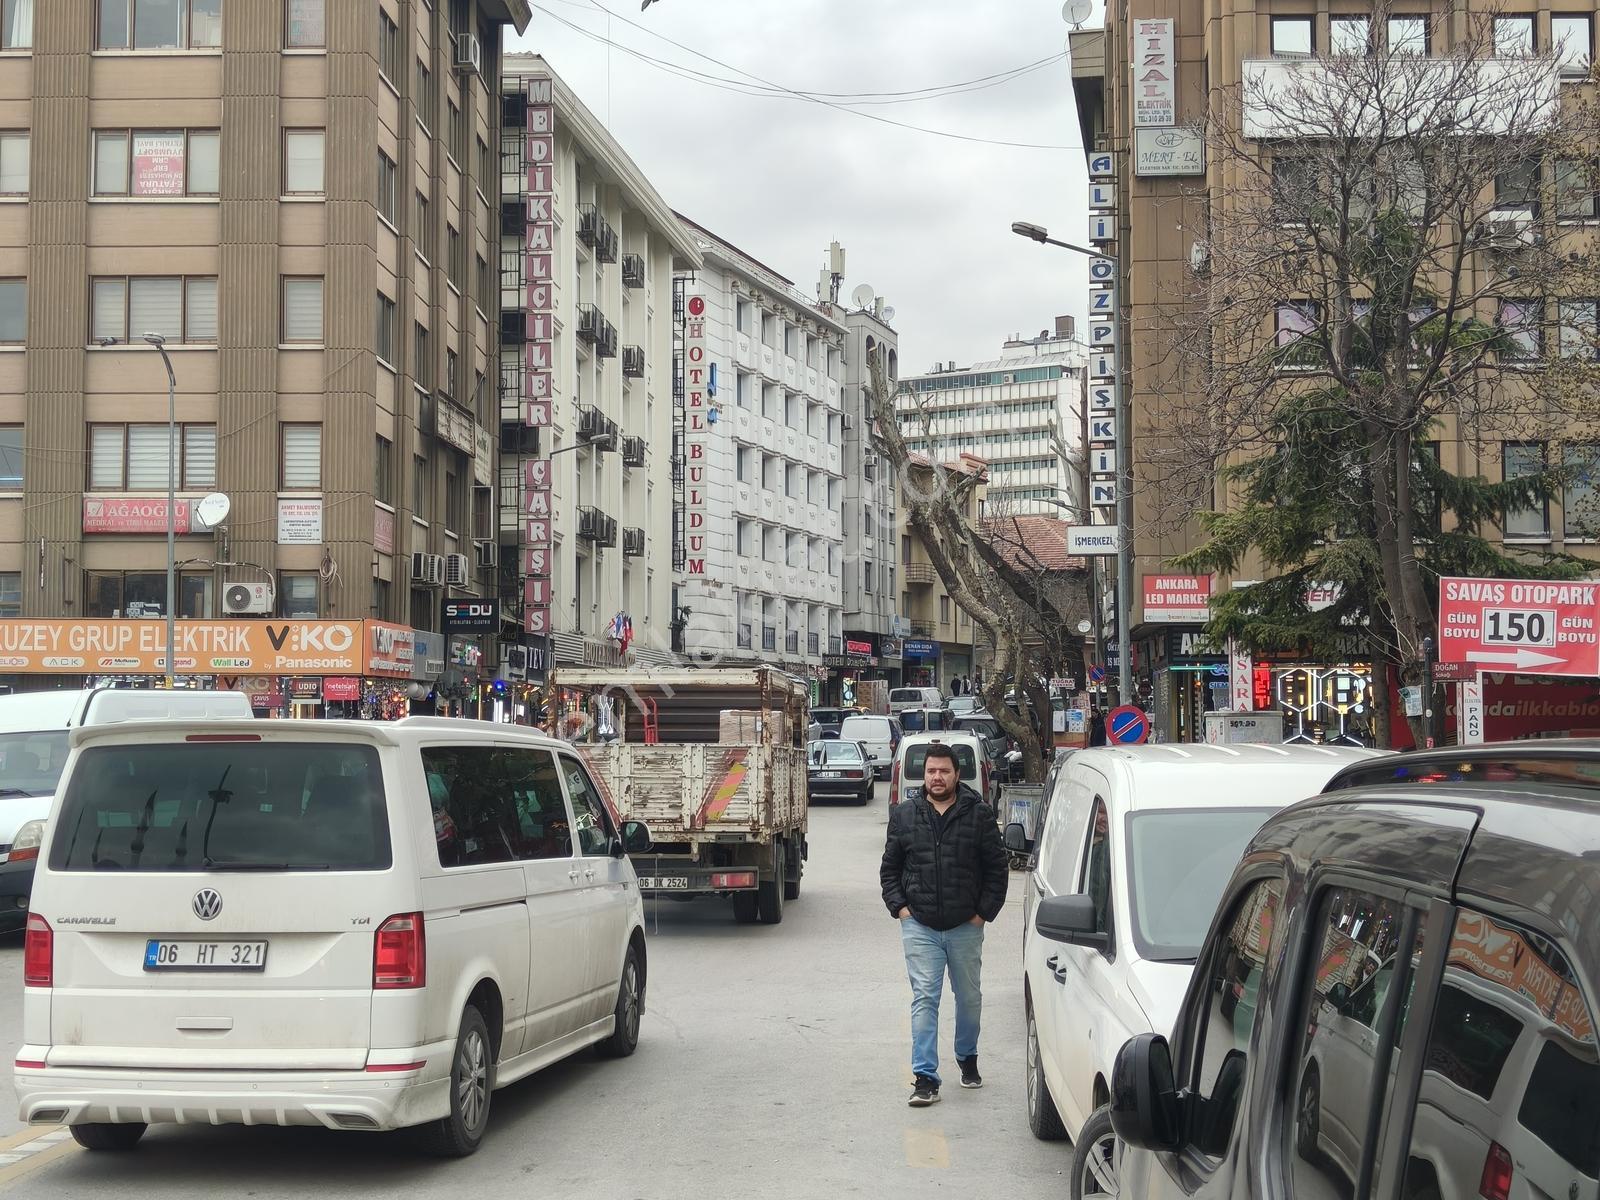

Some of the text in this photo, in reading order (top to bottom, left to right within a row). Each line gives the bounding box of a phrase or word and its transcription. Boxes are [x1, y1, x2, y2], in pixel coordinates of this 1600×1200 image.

[1139, 23, 1169, 97] HIZAL
[1138, 97, 1171, 109] ELEKTRİK
[1142, 151, 1176, 163] MERT
[139, 180, 183, 188] E-FATURA
[1091, 156, 1114, 501] ALİ ÖZPİŞKİN
[688, 324, 705, 574] HOTEL BULDUM
[1155, 578, 1199, 590] ANKARA
[1145, 593, 1209, 605] LED MARKET
[1446, 582, 1596, 606] SAVAŞ OTOPARK
[1447, 612, 1477, 625] GÜN
[1488, 612, 1545, 643] 150
[1561, 617, 1593, 629] GÜN
[0, 624, 63, 652] UZEY
[68, 625, 133, 652] GRUP
[1443, 627, 1597, 644] BOYU BOYU
[213, 657, 250, 667] Wall Led
[264, 655, 353, 670] by Panasonic
[823, 656, 844, 666] HOTEL
[1435, 662, 1459, 672] DOĞAN
[1468, 707, 1480, 737] PANO
[639, 878, 650, 888] 06
[666, 877, 687, 888] 2524
[56, 917, 116, 925] CARAVELLE
[157, 944, 262, 964] 06 HT 321
